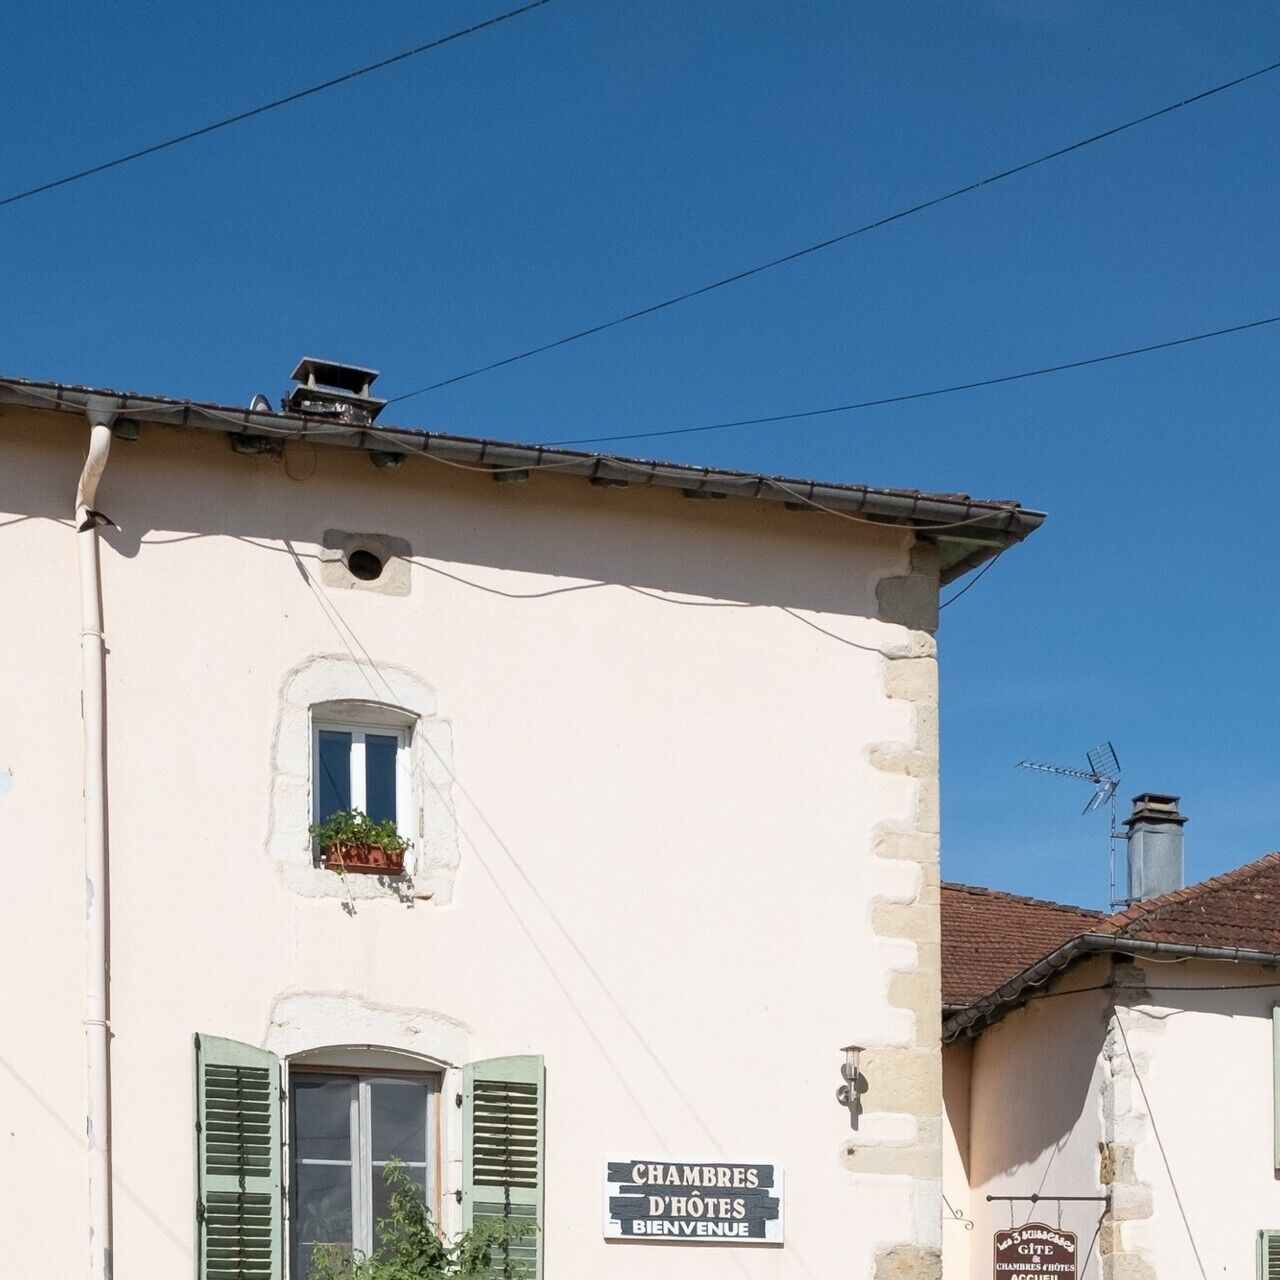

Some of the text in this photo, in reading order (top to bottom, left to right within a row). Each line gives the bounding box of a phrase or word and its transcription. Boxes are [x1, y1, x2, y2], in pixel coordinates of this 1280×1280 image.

[632, 1163, 759, 1188] CHAMBRES
[649, 1190, 746, 1219] D'HÔTES
[632, 1219, 749, 1236] BIENVENUE
[1012, 1232, 1021, 1244] 3
[1018, 1242, 1054, 1255] GÎTE
[1032, 1255, 1041, 1263] &
[996, 1263, 1041, 1271] CHAMBRES
